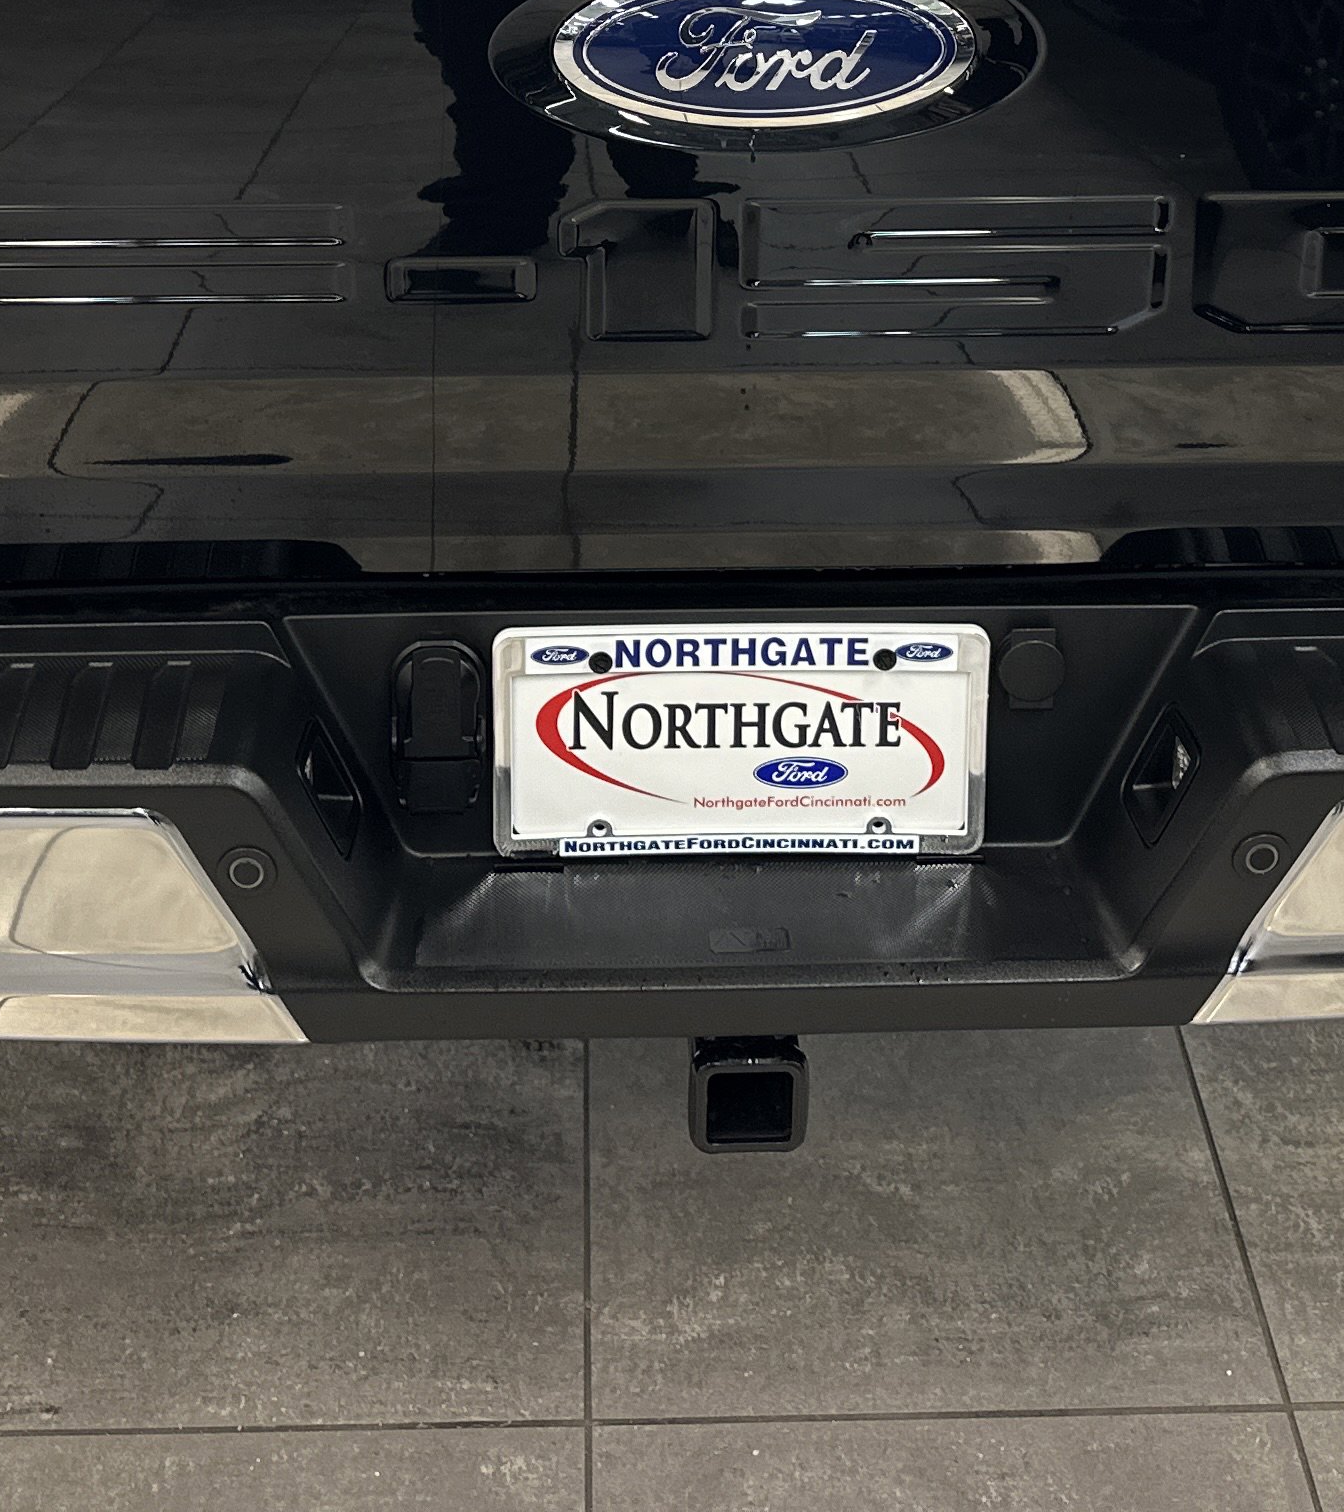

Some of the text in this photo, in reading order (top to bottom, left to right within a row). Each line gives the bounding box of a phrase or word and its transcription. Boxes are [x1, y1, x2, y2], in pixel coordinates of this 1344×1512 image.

[656, 6, 878, 91] Ford
[541, 648, 577, 662] Ford
[614, 637, 869, 668] NORTHGATE
[905, 644, 942, 659] Ford
[568, 690, 902, 751] NORTHGATE
[771, 761, 829, 782] Ford
[693, 795, 906, 811] NorthgateFordCincinnati.com
